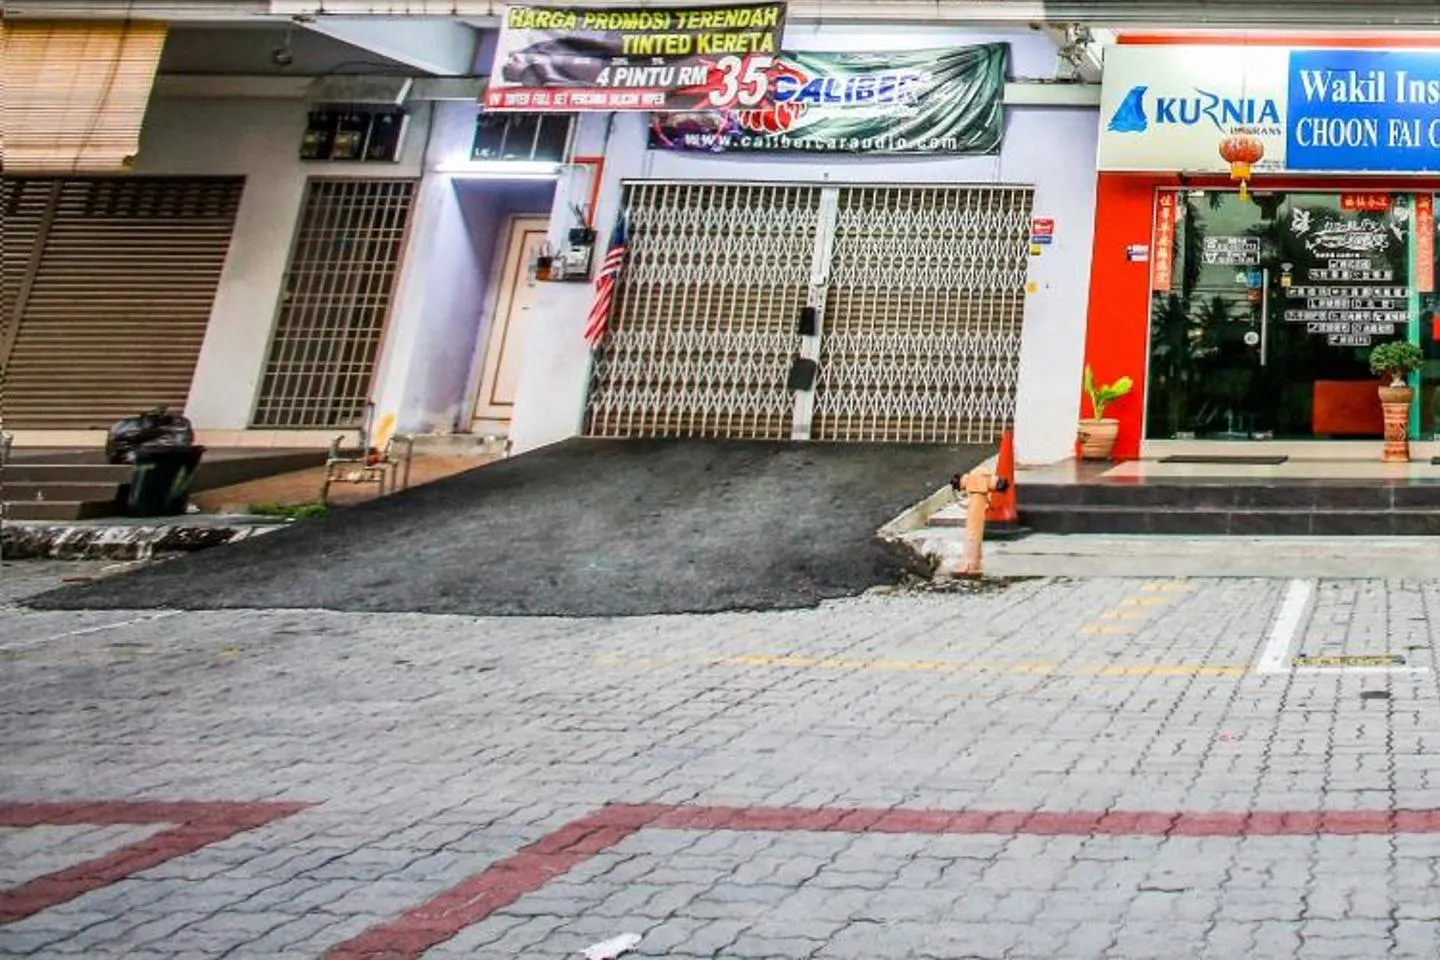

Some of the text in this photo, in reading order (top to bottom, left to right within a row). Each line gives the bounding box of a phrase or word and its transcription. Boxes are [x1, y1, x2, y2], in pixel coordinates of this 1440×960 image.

[508, 7, 779, 30] HARGA PROMOSI TERENDAH
[621, 33, 774, 54] TINTED KERETA
[596, 55, 774, 106] 4 PINTU RM 35
[1300, 70, 1385, 103] Wakil
[1156, 88, 1281, 132] KURNIA
[1296, 117, 1378, 148] CHOON
[1388, 118, 1421, 148] FAI
